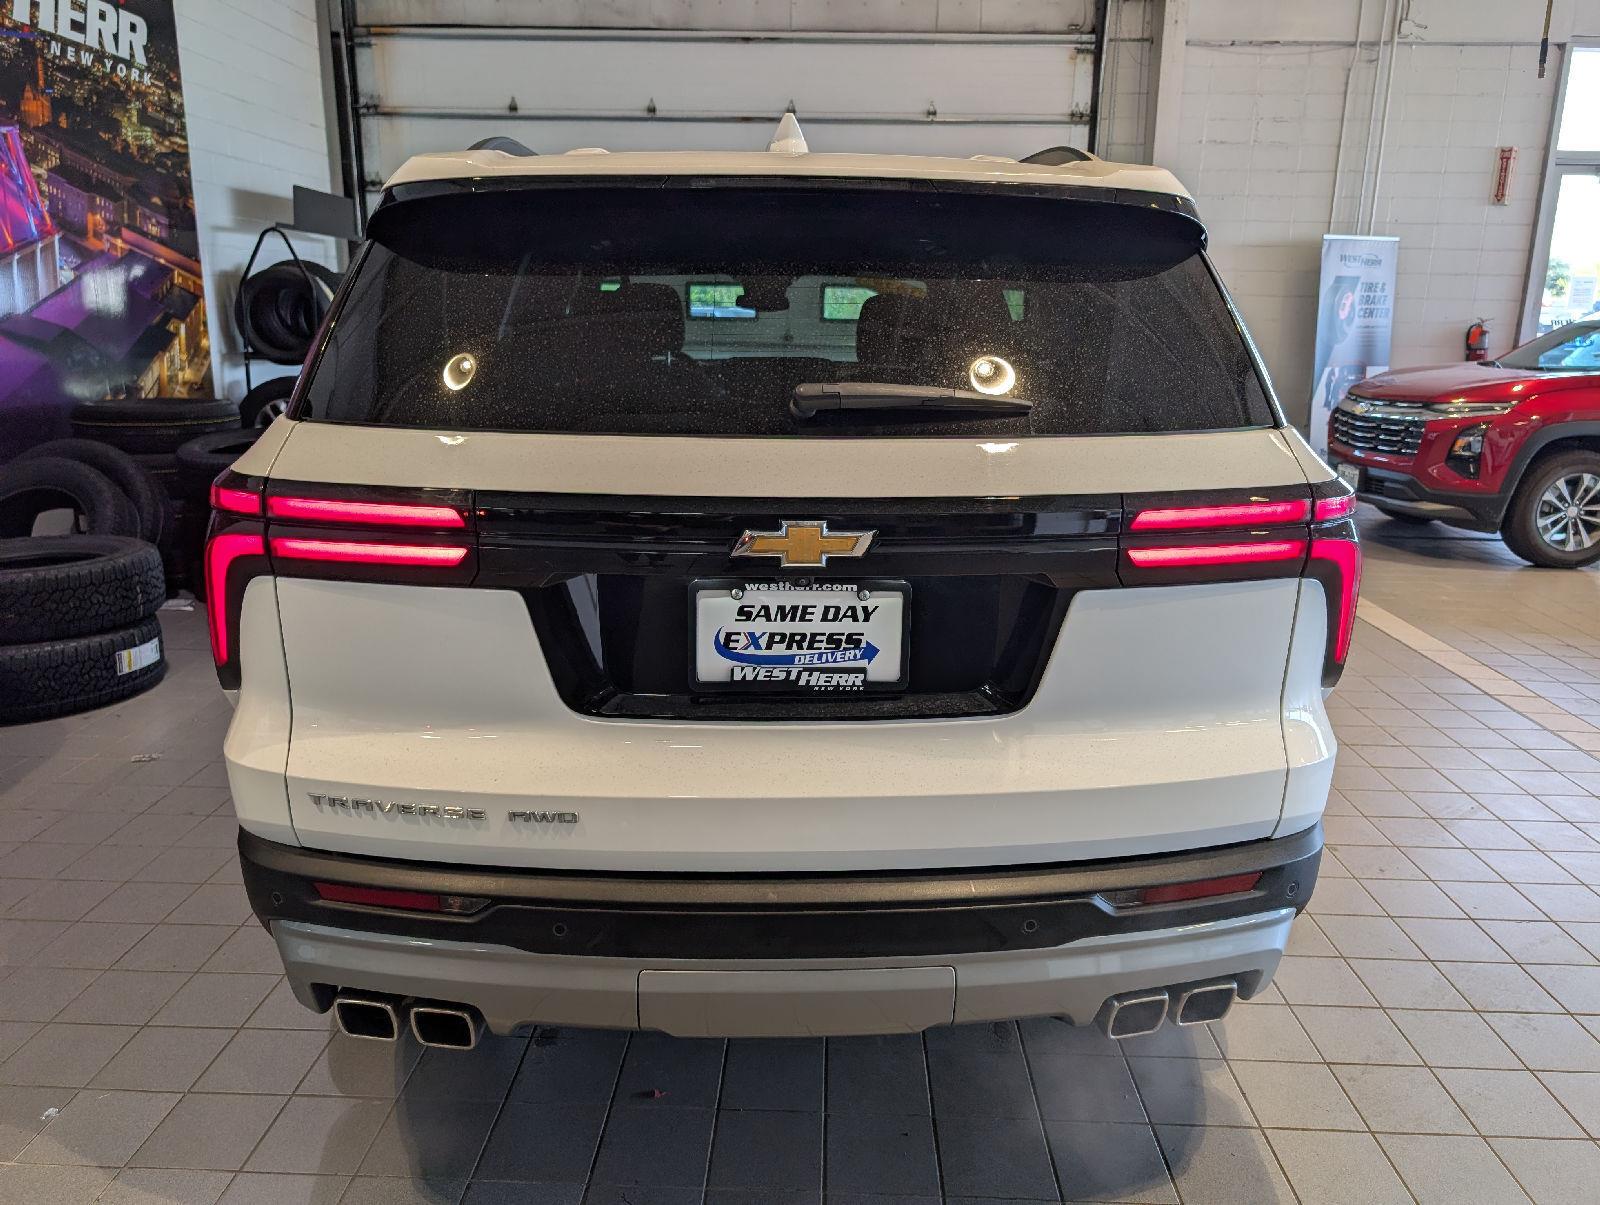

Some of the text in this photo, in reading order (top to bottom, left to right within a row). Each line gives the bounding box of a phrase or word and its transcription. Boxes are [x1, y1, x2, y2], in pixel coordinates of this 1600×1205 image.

[50, 41, 152, 87] NEW YORK
[1360, 282, 1379, 293] TIRE
[1359, 294, 1388, 306] BRAKE
[1357, 307, 1391, 319] CENTER
[734, 604, 879, 623] SAME DAY
[722, 631, 865, 651] EXPRESS
[793, 648, 865, 666] DELIVERY
[307, 792, 580, 824] TRAVERSE AWD
